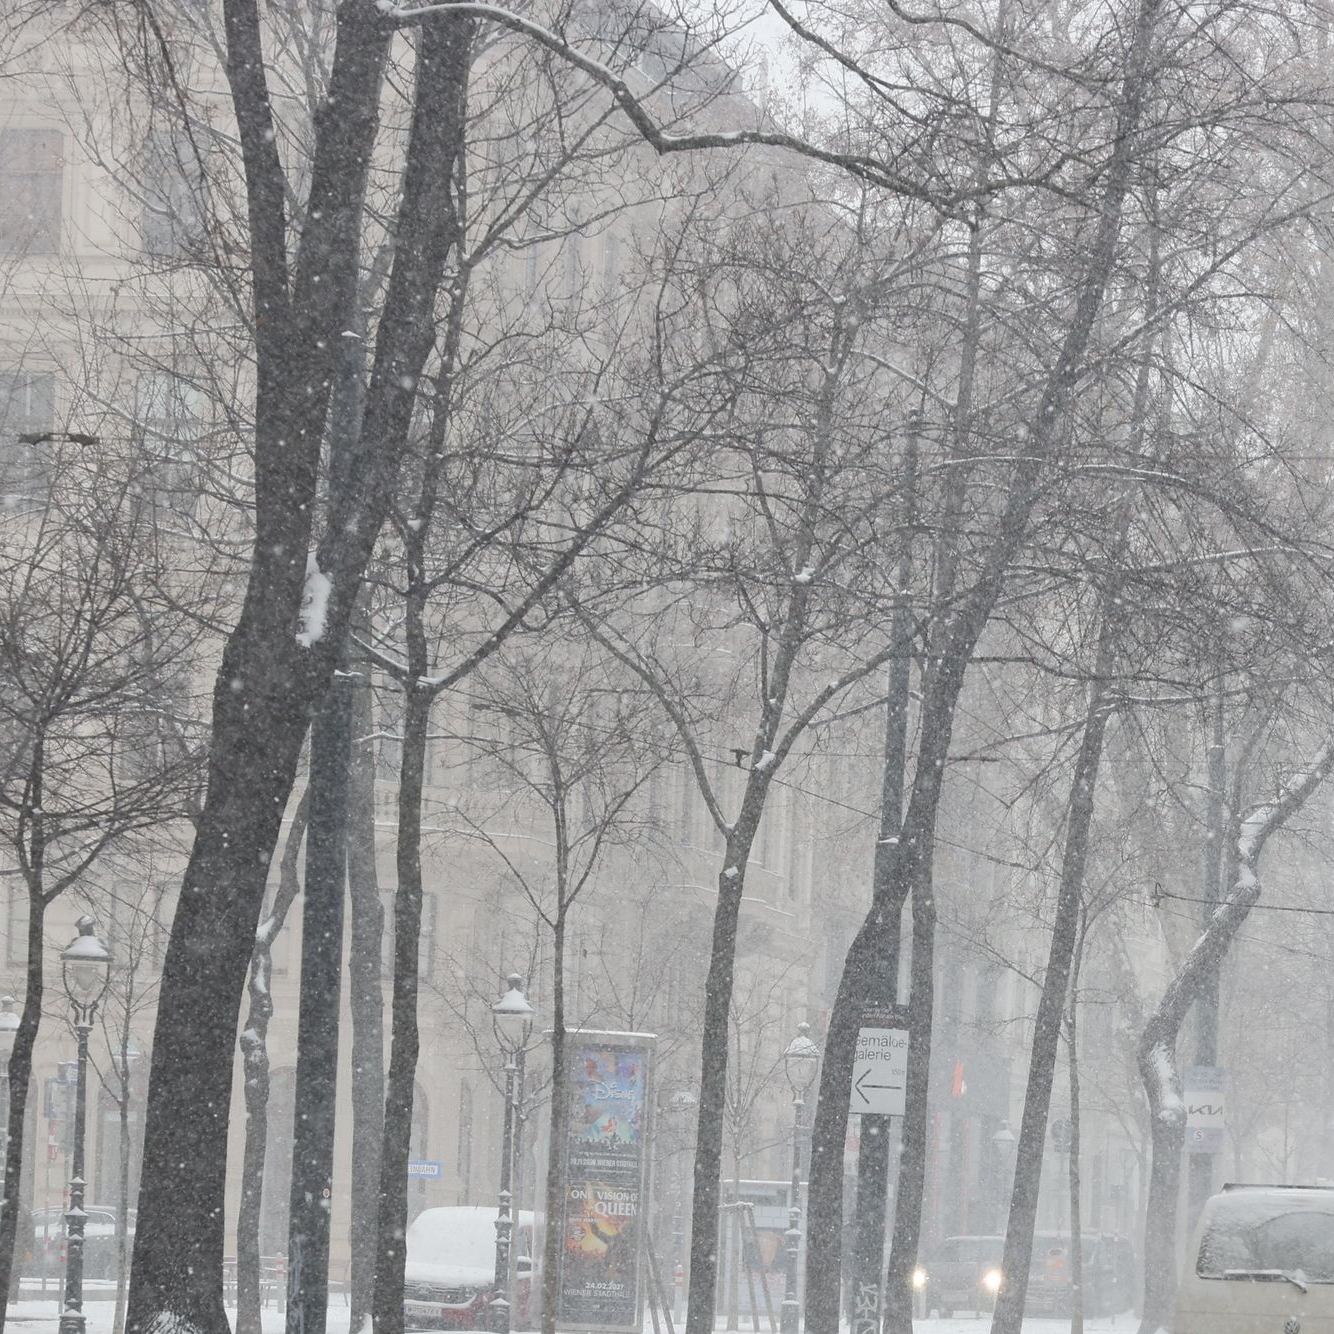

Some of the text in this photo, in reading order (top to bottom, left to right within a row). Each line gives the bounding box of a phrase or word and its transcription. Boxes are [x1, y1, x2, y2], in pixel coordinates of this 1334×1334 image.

[587, 1078, 636, 1102] Disney
[408, 1165, 437, 1174] INBAHN
[597, 1191, 629, 1201] VISION
[594, 1201, 637, 1217] QUEEN
